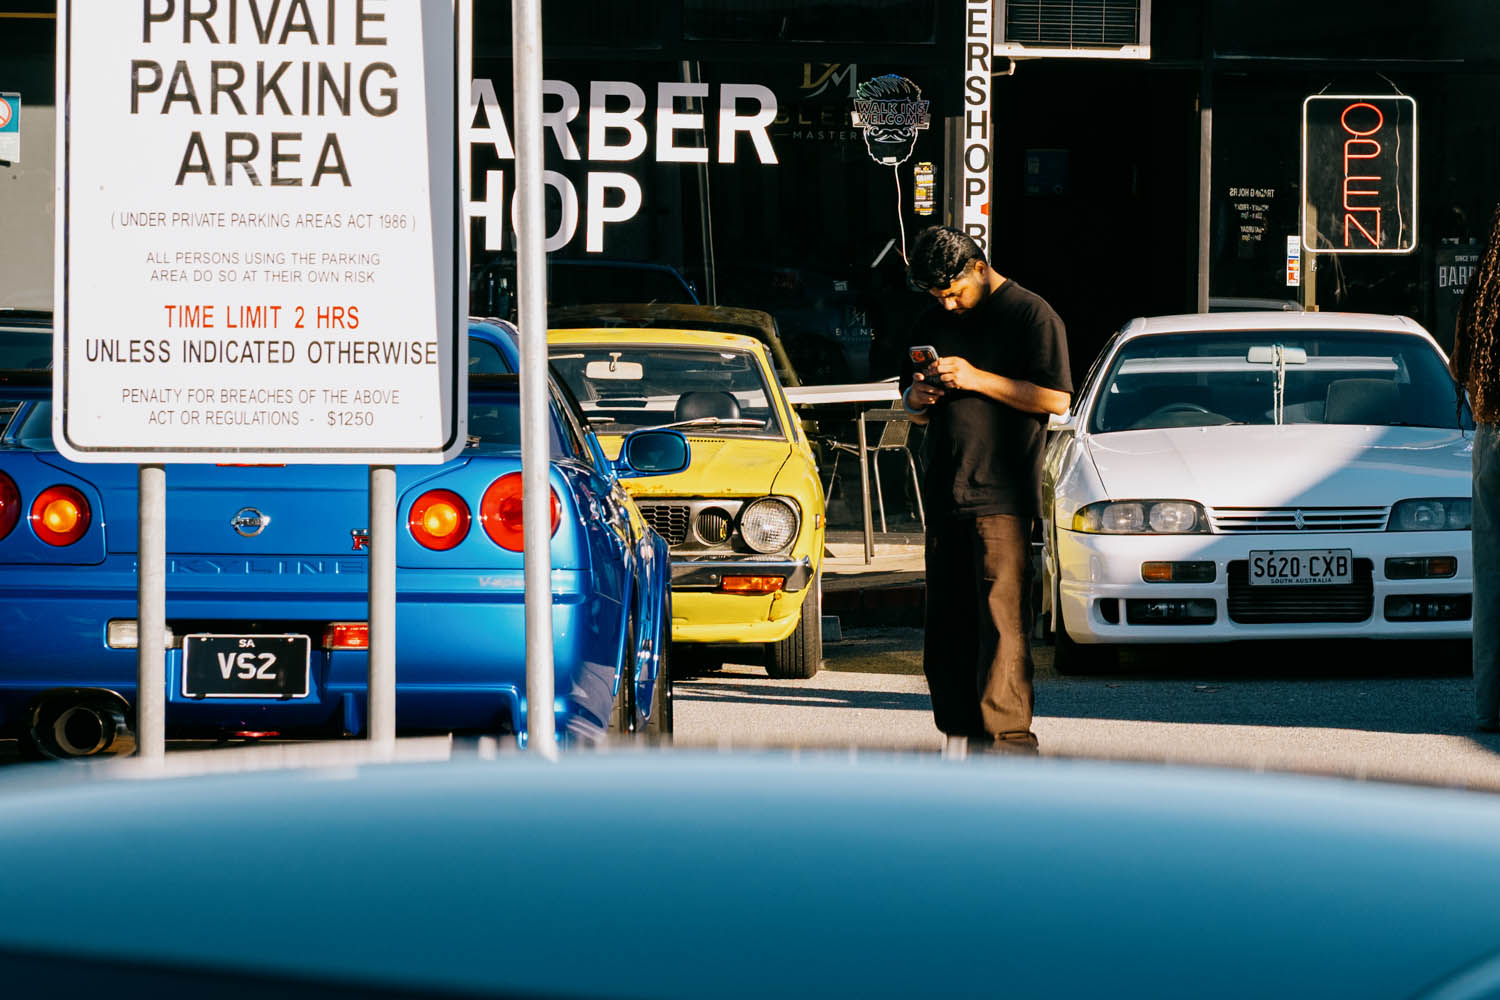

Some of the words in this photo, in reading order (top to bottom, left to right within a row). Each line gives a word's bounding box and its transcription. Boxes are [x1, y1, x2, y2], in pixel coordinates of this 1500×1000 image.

[130, 60, 398, 116] PARKING
[859, 102, 896, 114] WALK
[901, 102, 926, 115] INS
[463, 78, 779, 164] ARBER
[859, 113, 924, 125] WELCOME
[792, 131, 867, 140] MASTER
[175, 131, 351, 187] AREA
[1341, 103, 1384, 249] OPEN
[463, 169, 643, 252] HOP
[120, 212, 166, 227] UNDER
[172, 212, 225, 228] PRIVATE
[231, 213, 290, 229] PARKING
[295, 213, 342, 229] AREAS
[347, 214, 374, 229] ACT
[379, 214, 407, 229] 1986
[146, 252, 170, 264] ALL
[176, 252, 240, 265] PERSONS
[244, 253, 286, 265] USING
[291, 253, 317, 265] THE
[322, 253, 381, 266] PARKING
[150, 270, 188, 282] AREA
[193, 270, 214, 283] DO
[218, 270, 238, 283] SO
[242, 270, 258, 283] AT
[264, 270, 303, 283] THEIR
[308, 270, 340, 283] OWN
[344, 270, 375, 283] RISK
[165, 305, 214, 328] TIME
[227, 306, 281, 328] LIMIT
[295, 306, 304, 328] 2
[318, 306, 359, 329] HRS
[87, 339, 170, 363] UNLESS
[184, 340, 294, 363] INDICATED
[308, 341, 438, 365] OTHERWISE
[122, 388, 182, 404] PENALTY
[188, 388, 215, 404] FOR
[220, 388, 294, 404] BREACHES
[298, 388, 317, 404] OF
[322, 389, 348, 405] THE
[354, 389, 400, 405] ABOVE
[148, 410, 174, 425] ACT
[180, 410, 200, 425] OR
[205, 411, 300, 426] REGULATIONS
[327, 411, 374, 427] $1250
[132, 561, 365, 574] KYLINE
[239, 639, 256, 648] SA
[218, 653, 277, 679] VS2
